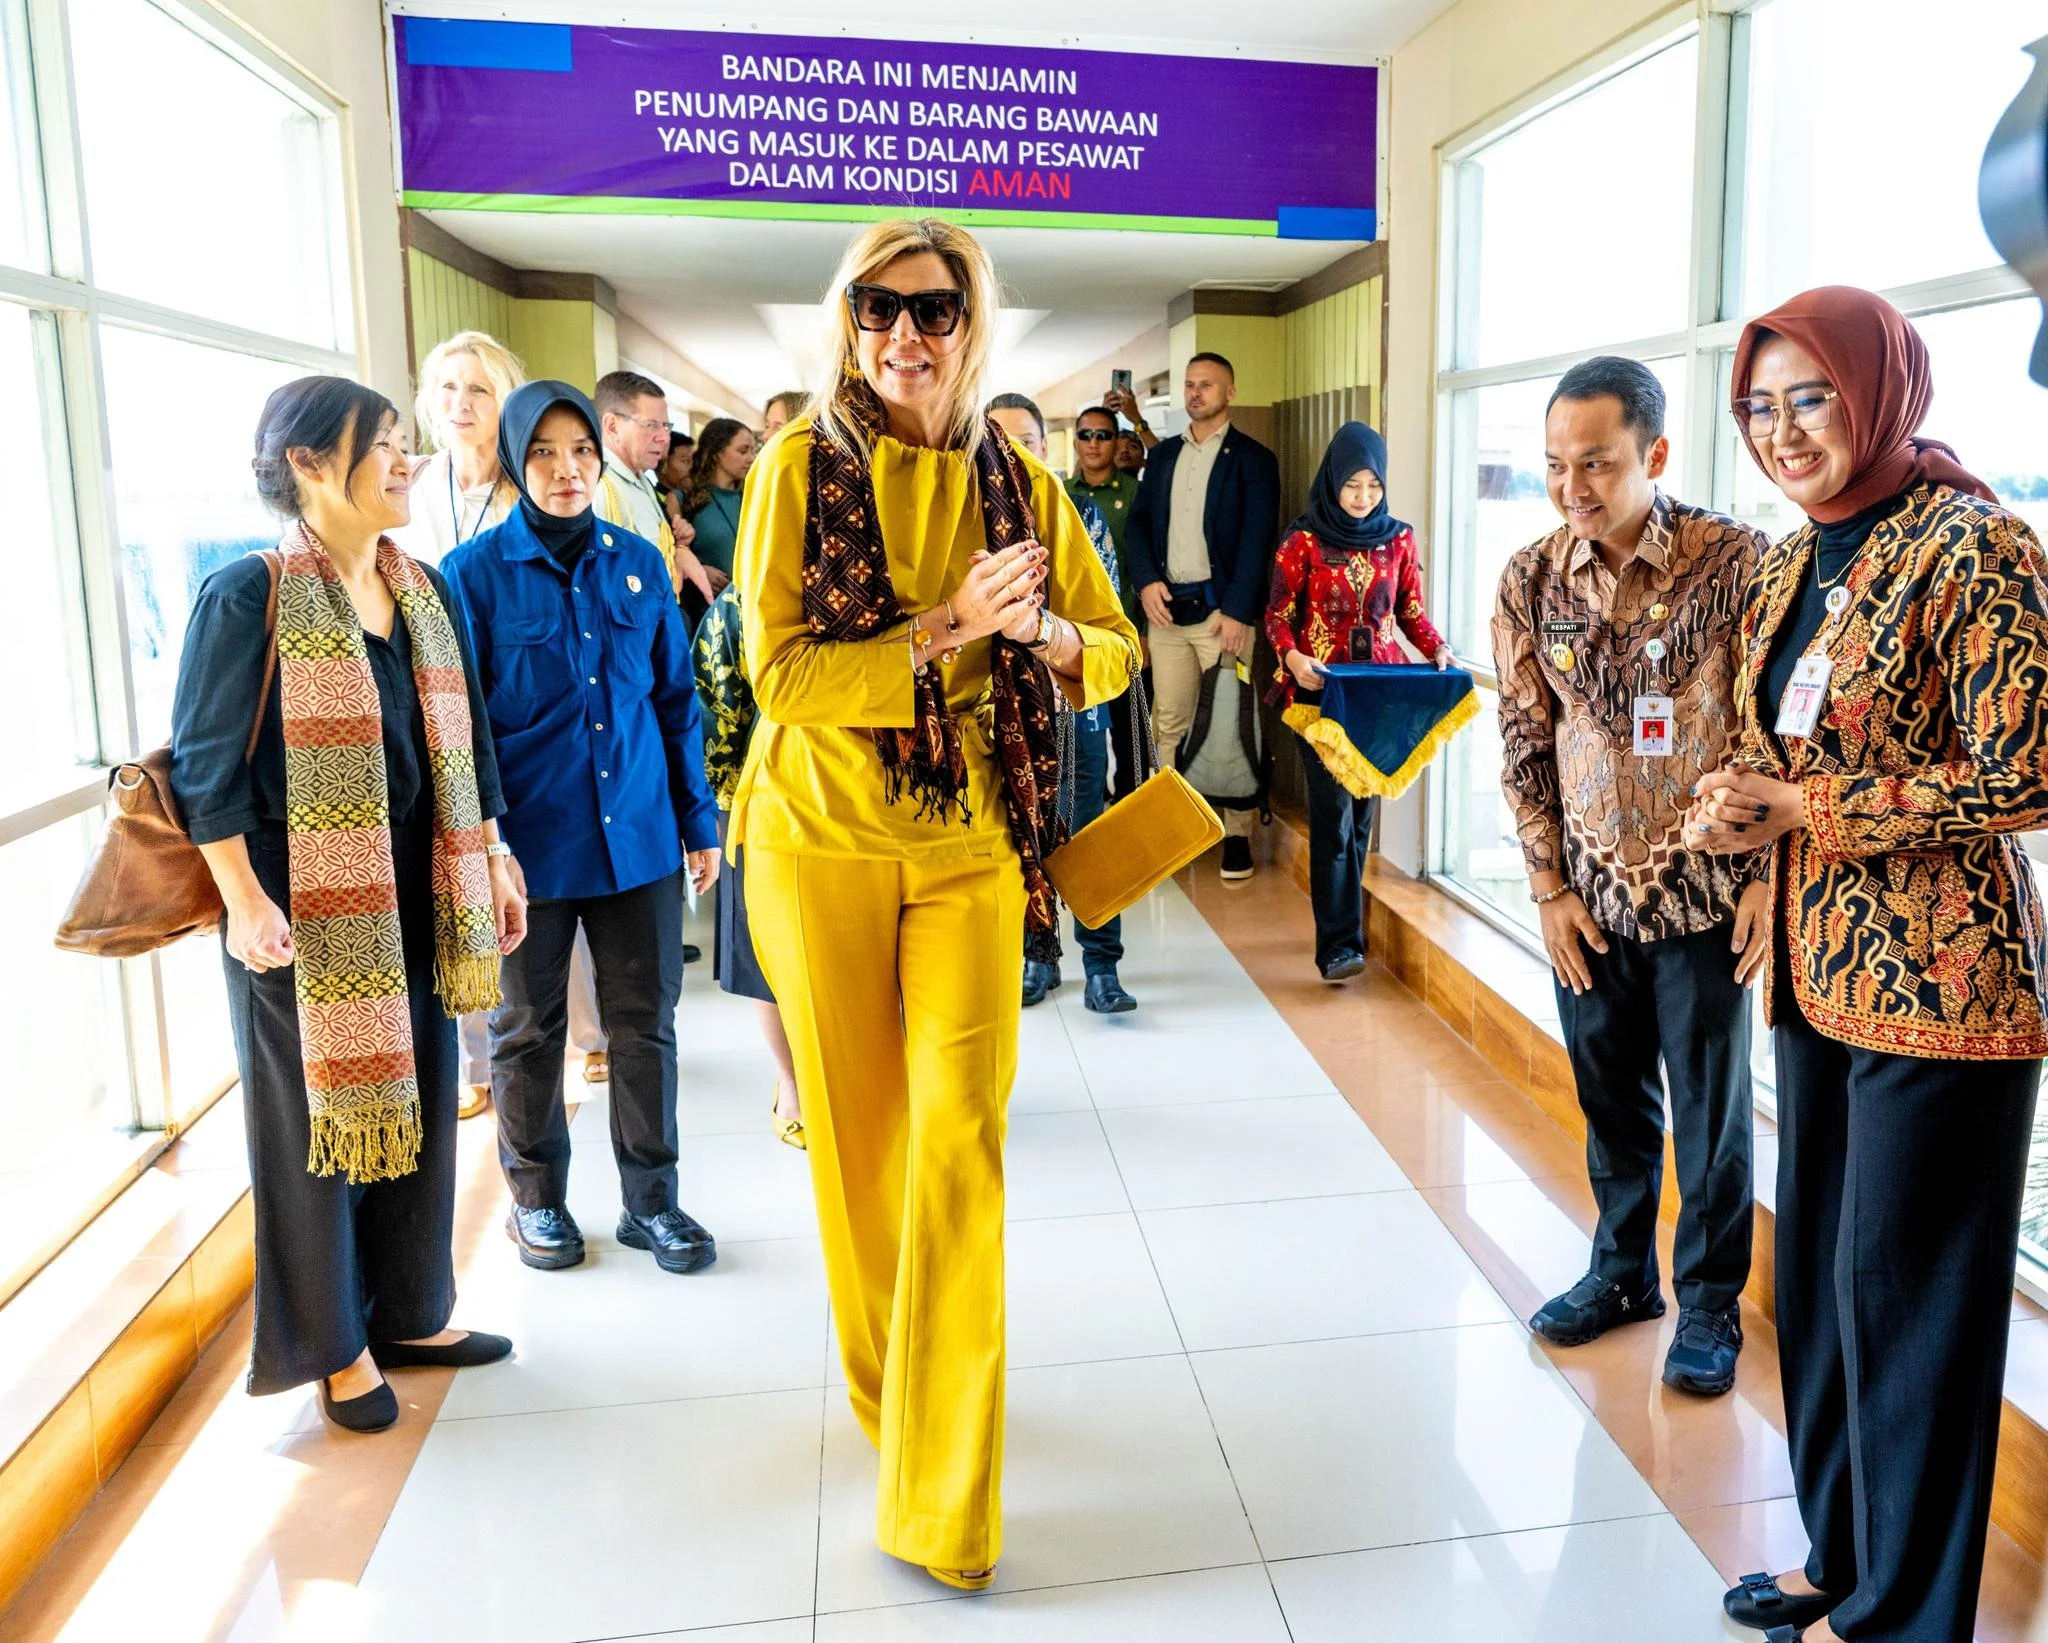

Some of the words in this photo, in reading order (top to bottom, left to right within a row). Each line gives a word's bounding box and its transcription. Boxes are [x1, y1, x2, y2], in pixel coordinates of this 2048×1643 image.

[721, 54, 866, 87] BANDARA
[874, 61, 912, 88] INI
[921, 63, 1077, 96] MENJAMIN
[634, 89, 828, 123] PENUMPANG
[837, 98, 899, 126] DAN
[909, 101, 1027, 131] BARANG
[1036, 107, 1158, 137] BAWAAN
[657, 126, 739, 155] YANG
[749, 130, 856, 159] MASUK
[864, 134, 898, 161] KE
[907, 136, 1009, 165] DALAM
[1018, 141, 1145, 170] PESAWAT
[729, 161, 834, 190] DALAM
[844, 165, 958, 194] KONDISI
[969, 169, 1072, 199] AMAN
